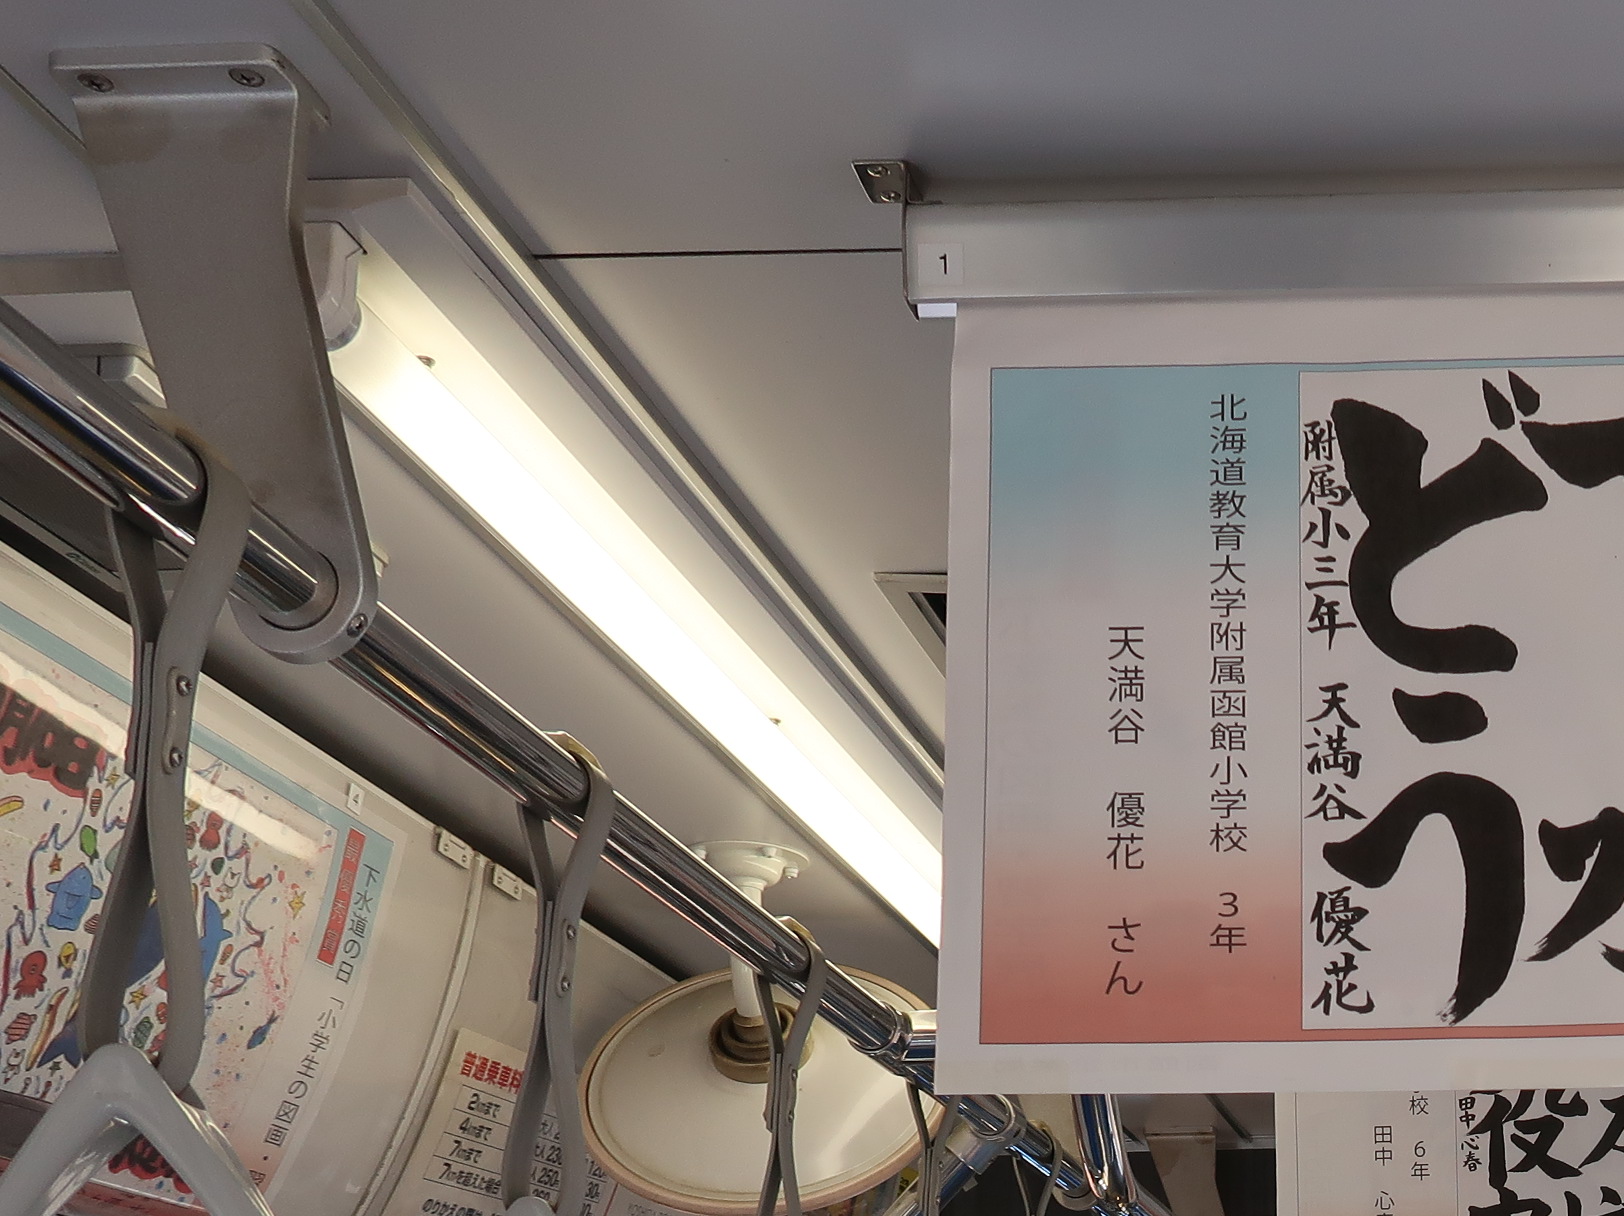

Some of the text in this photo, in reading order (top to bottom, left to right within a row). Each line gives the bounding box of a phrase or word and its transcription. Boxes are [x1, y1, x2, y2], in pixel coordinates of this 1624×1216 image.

[1104, 626, 1147, 997] 天満谷 優花 さん
[1208, 393, 1248, 855] 北海道教育大学附属函館小学校
[1302, 418, 1375, 1018] 附属小三年 天満谷 優花
[1323, 370, 1548, 1026] どう
[1374, 1125, 1393, 1167] 田中
[1411, 1141, 1431, 1182] 6年
